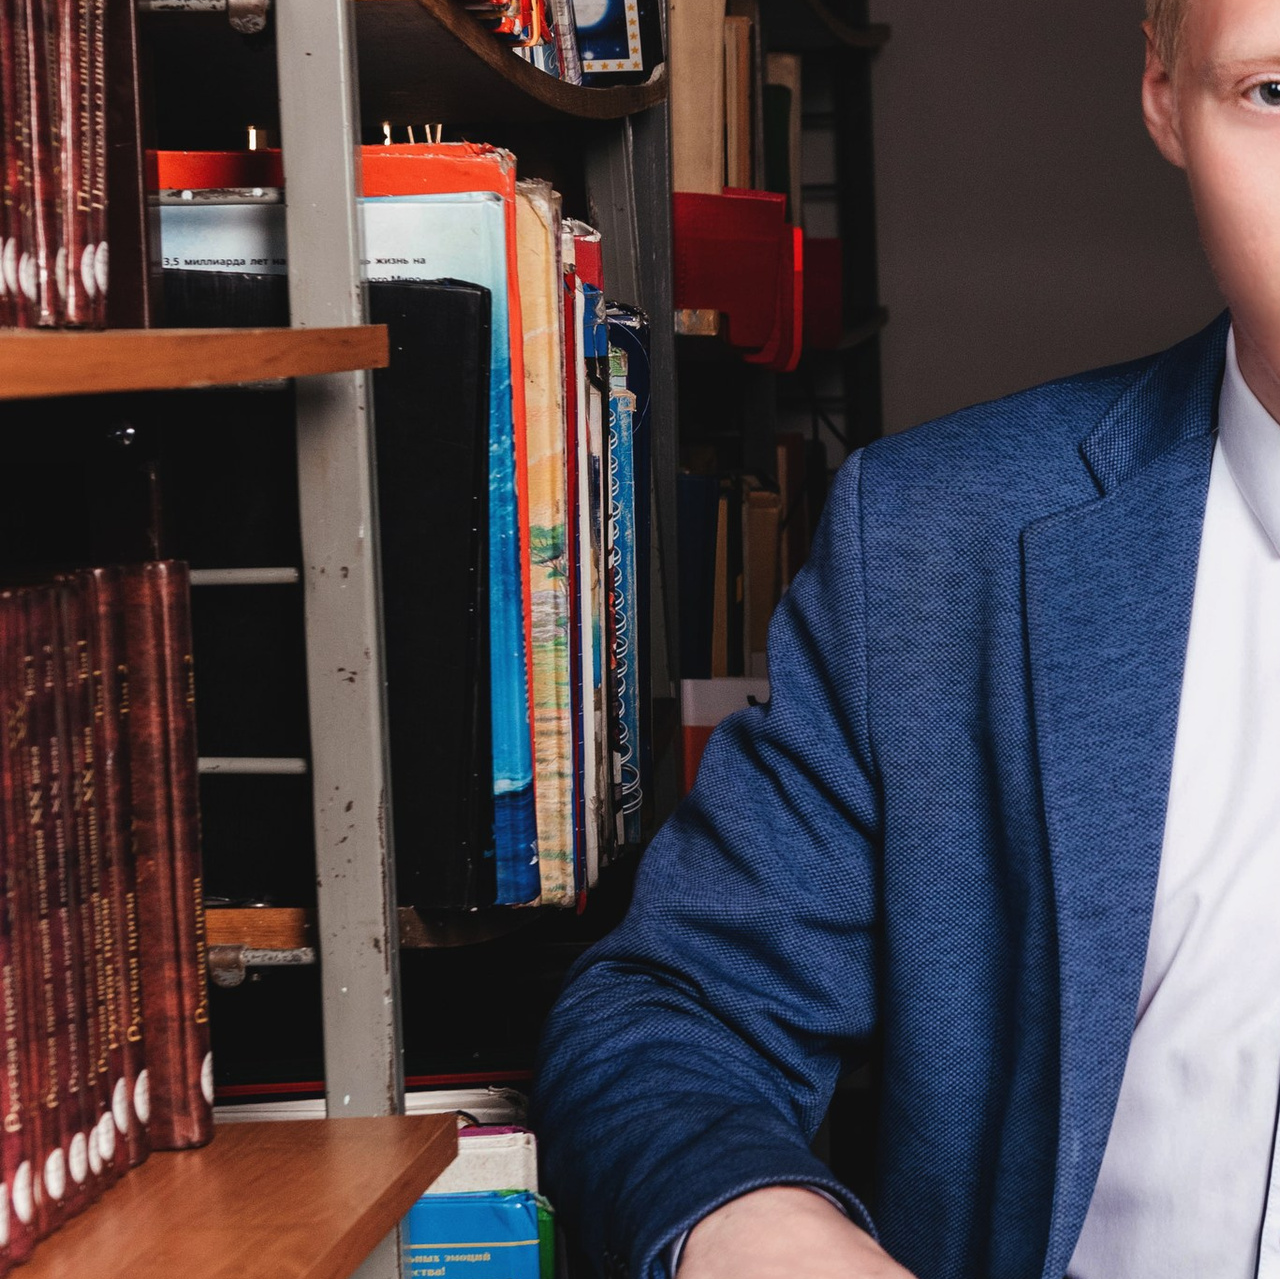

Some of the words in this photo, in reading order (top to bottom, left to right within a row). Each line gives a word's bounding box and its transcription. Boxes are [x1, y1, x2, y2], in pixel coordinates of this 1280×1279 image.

[163, 257, 180, 268] 3,5
[184, 258, 246, 268] миллиарда
[250, 258, 268, 266] лет
[376, 257, 409, 265] жизнь
[413, 257, 426, 265] на
[445, 1252, 491, 1263] эмоций
